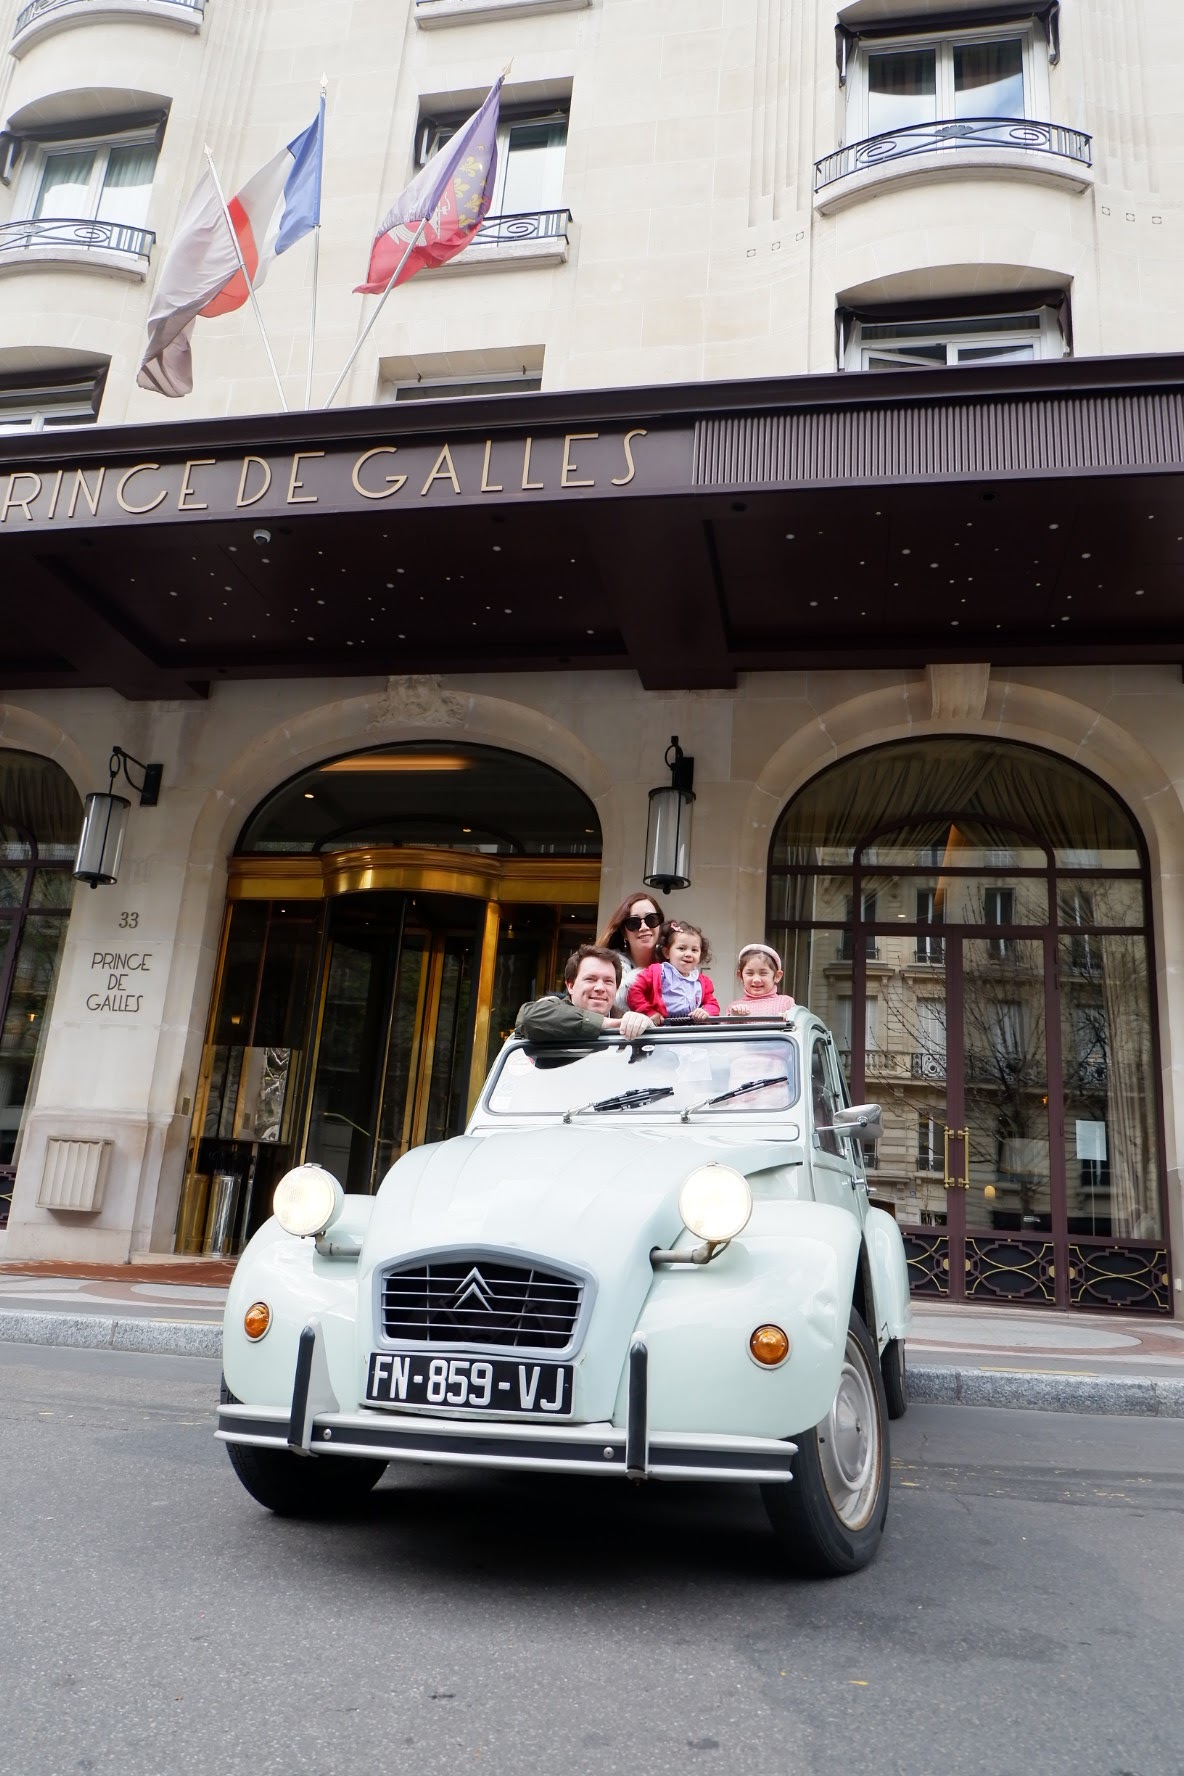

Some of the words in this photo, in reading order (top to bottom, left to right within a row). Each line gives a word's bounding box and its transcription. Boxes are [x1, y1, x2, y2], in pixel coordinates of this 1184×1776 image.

[236, 451, 325, 507] DE
[351, 429, 648, 499] GALLES
[119, 912, 139, 928] 33
[91, 953, 152, 971] PRINCE
[108, 974, 128, 990] DE
[86, 994, 144, 1012] GALLES
[371, 1355, 565, 1411] FN-859-VJ
